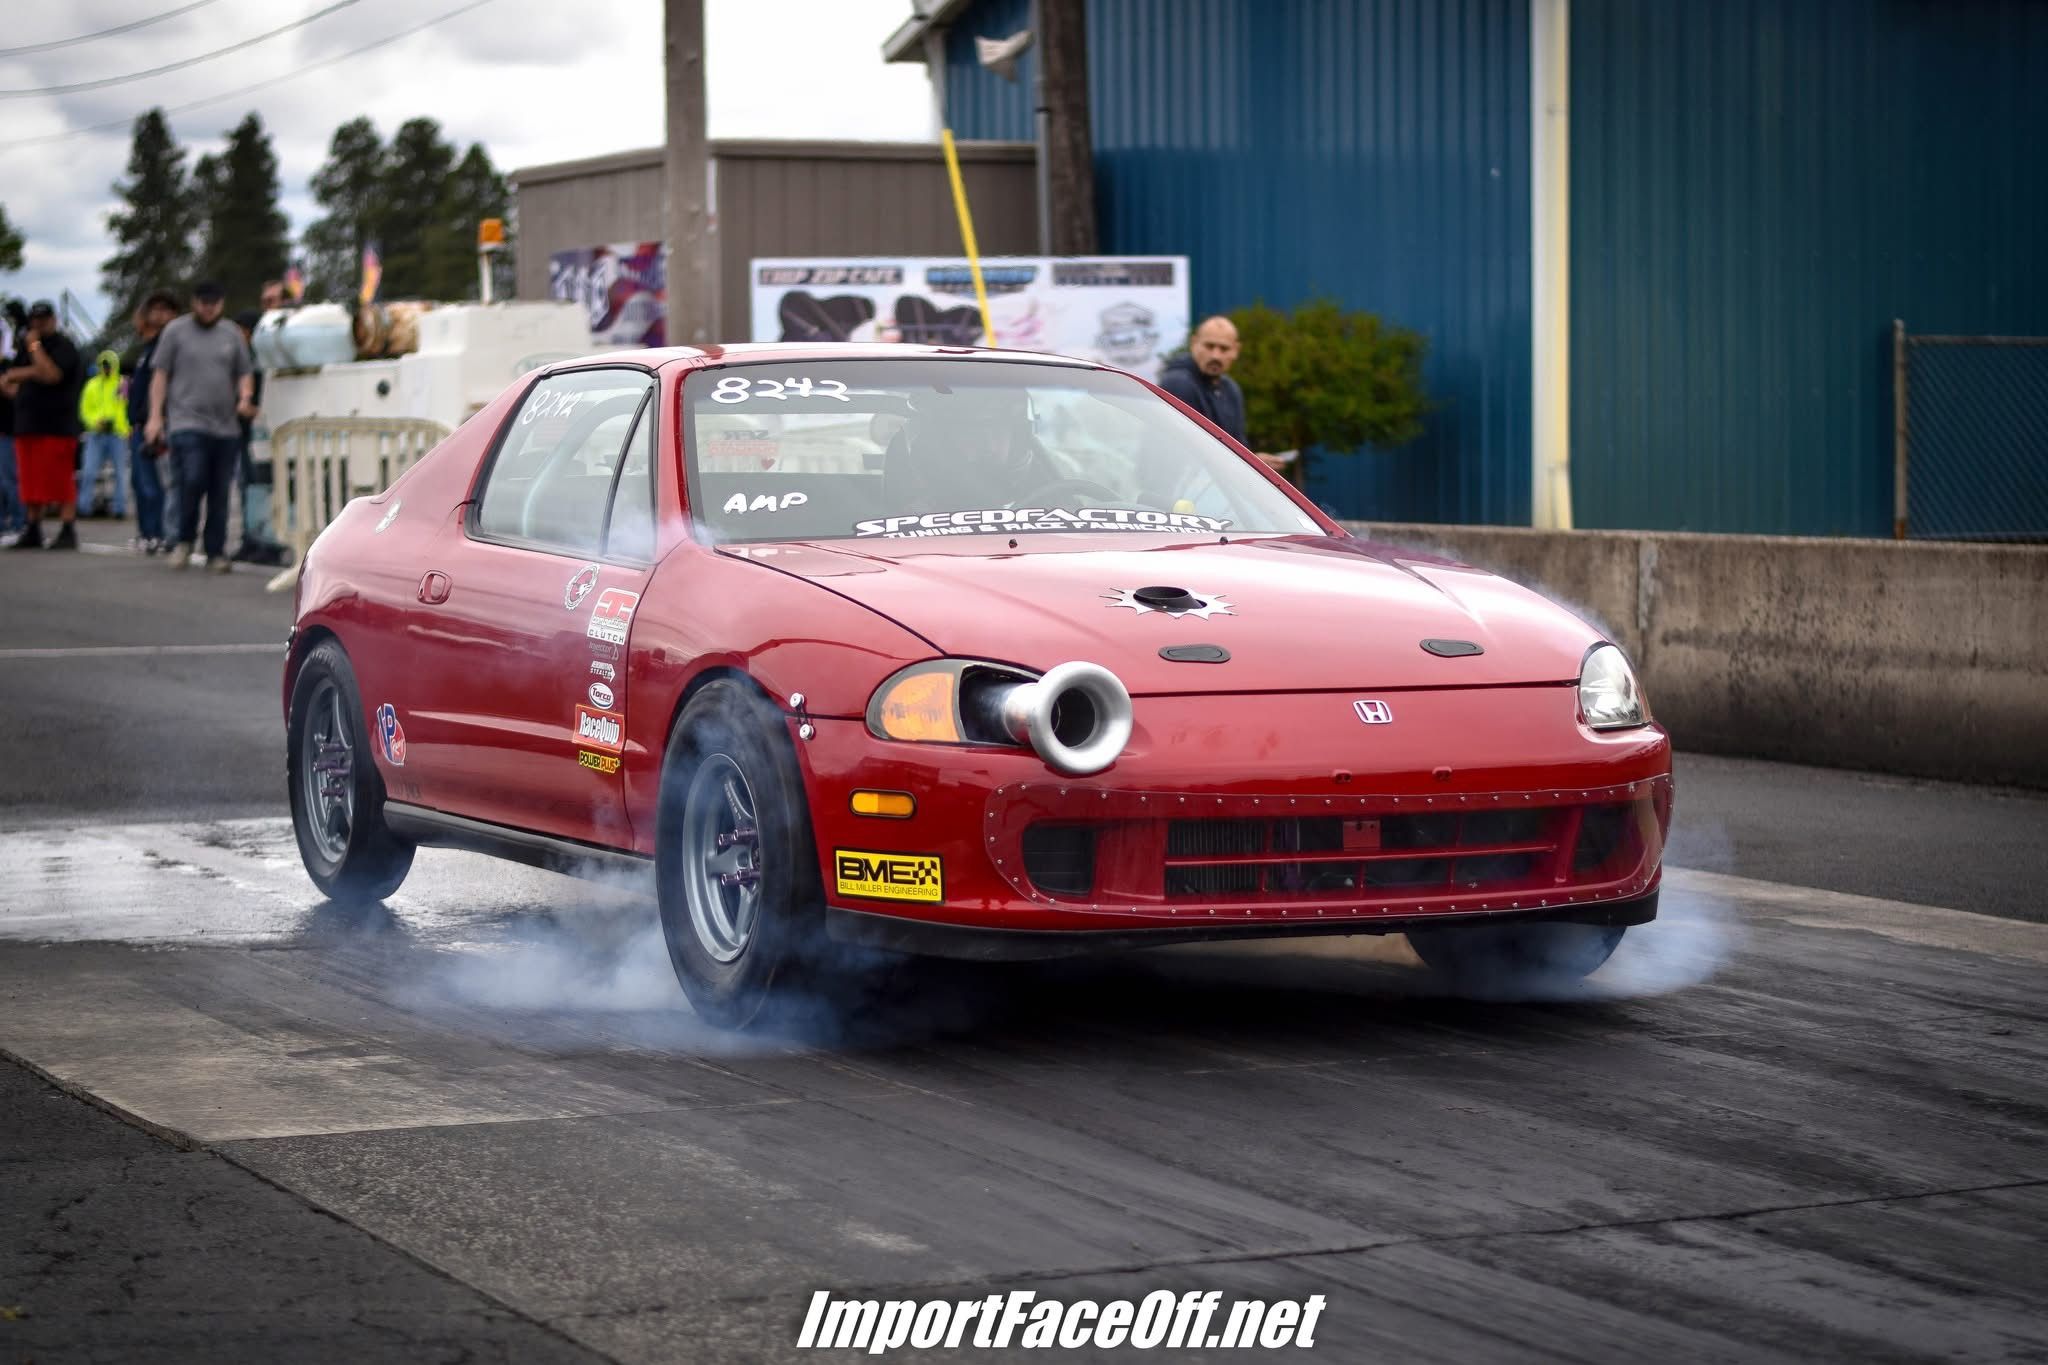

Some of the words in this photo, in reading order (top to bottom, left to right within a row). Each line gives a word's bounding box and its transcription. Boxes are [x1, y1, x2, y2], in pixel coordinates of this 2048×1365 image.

[711, 377, 850, 404] 8242
[522, 389, 584, 425] 8242
[723, 492, 808, 514] AMP
[856, 508, 1233, 537] SPEEDFACTORY
[883, 525, 974, 540] TUNING
[979, 524, 998, 532] &
[1005, 522, 1068, 531] RACE
[589, 629, 625, 643] CLUTCH
[593, 687, 612, 701] Torco
[579, 711, 621, 745] RaceQuip
[579, 752, 601, 768] POWER
[838, 856, 916, 886] BME
[840, 882, 855, 890] BILL
[856, 883, 882, 893] MILLER
[883, 885, 939, 897] ENGINEERING
